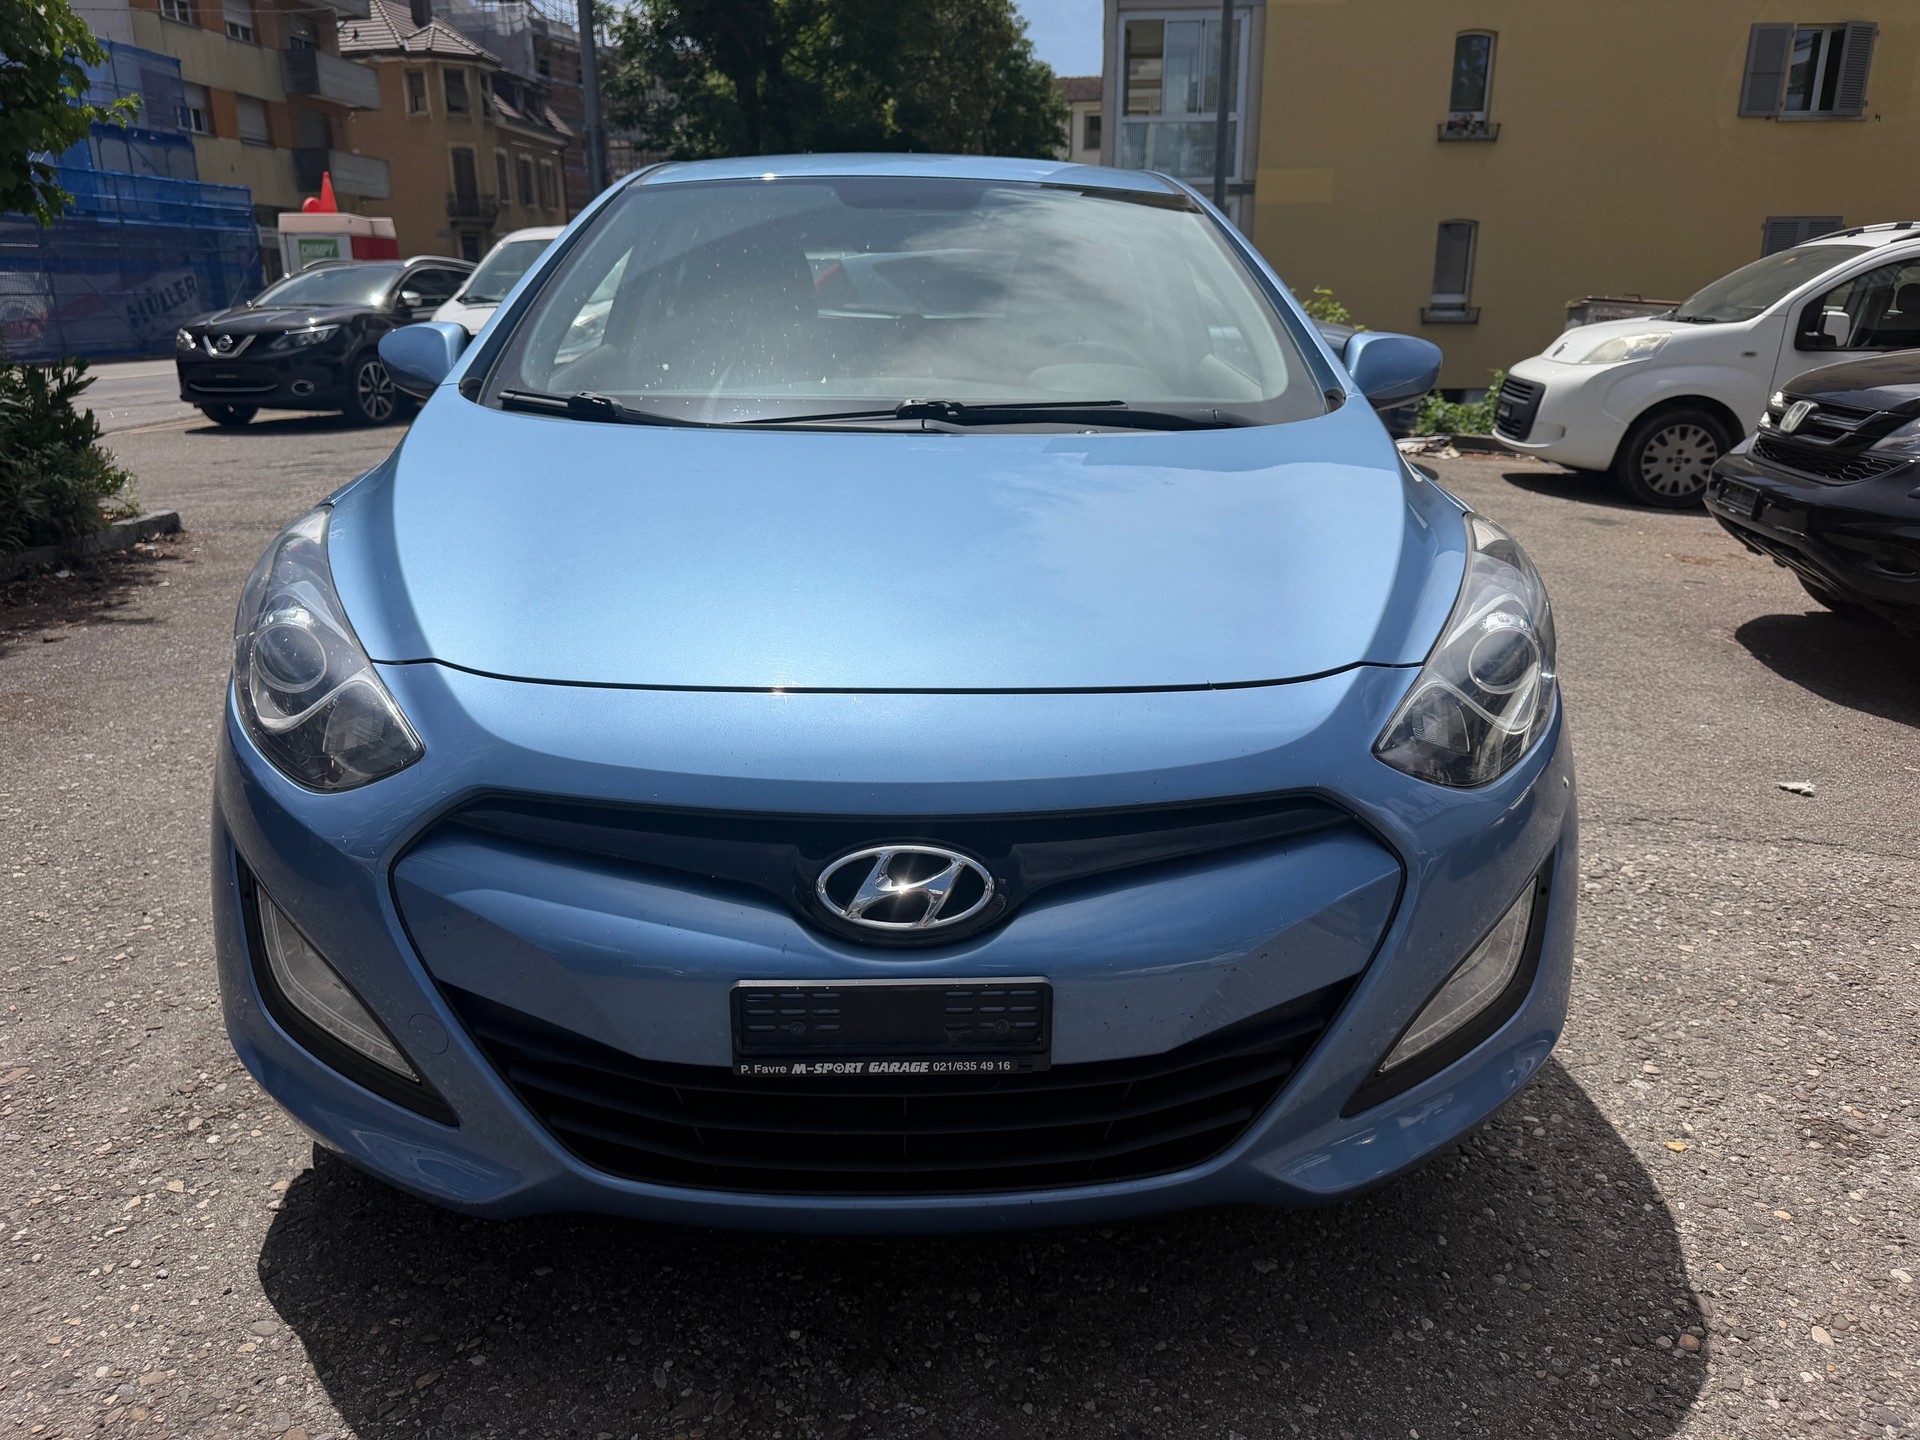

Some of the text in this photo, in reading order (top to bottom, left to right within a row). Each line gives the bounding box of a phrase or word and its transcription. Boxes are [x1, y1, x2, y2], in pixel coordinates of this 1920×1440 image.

[301, 243, 335, 257] CHIMPY
[741, 1061, 1011, 1074] P. Favre M-SPORT GARAGE 021/635 49 16
